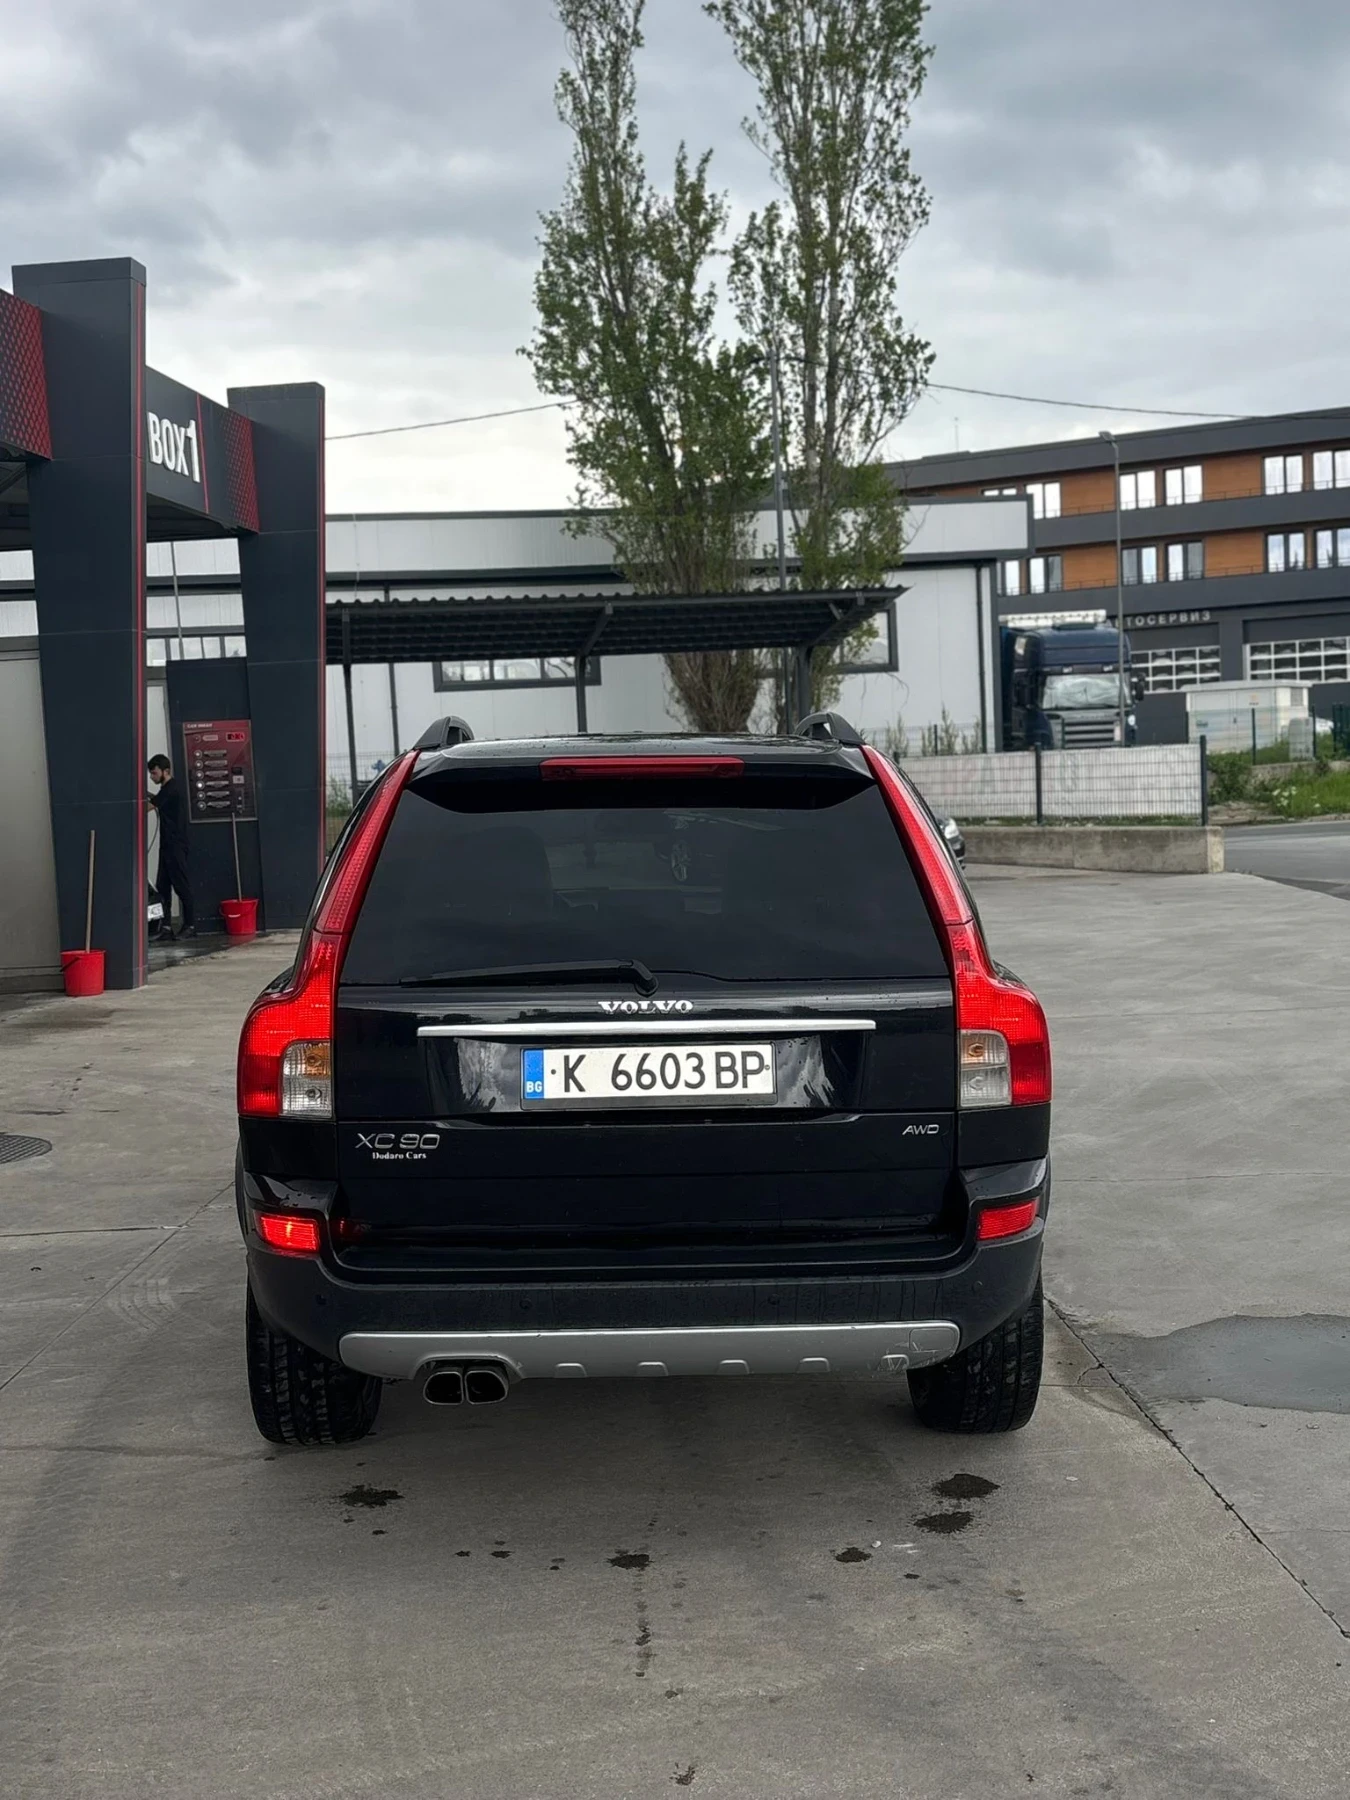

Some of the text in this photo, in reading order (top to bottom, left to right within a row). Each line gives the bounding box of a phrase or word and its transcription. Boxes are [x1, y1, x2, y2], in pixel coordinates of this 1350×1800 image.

[598, 1000, 693, 1014] VOLVO
[563, 1054, 586, 1092] K
[526, 1081, 542, 1093] BG
[902, 1124, 940, 1136] AWD
[406, 1151, 427, 1160] Cars
